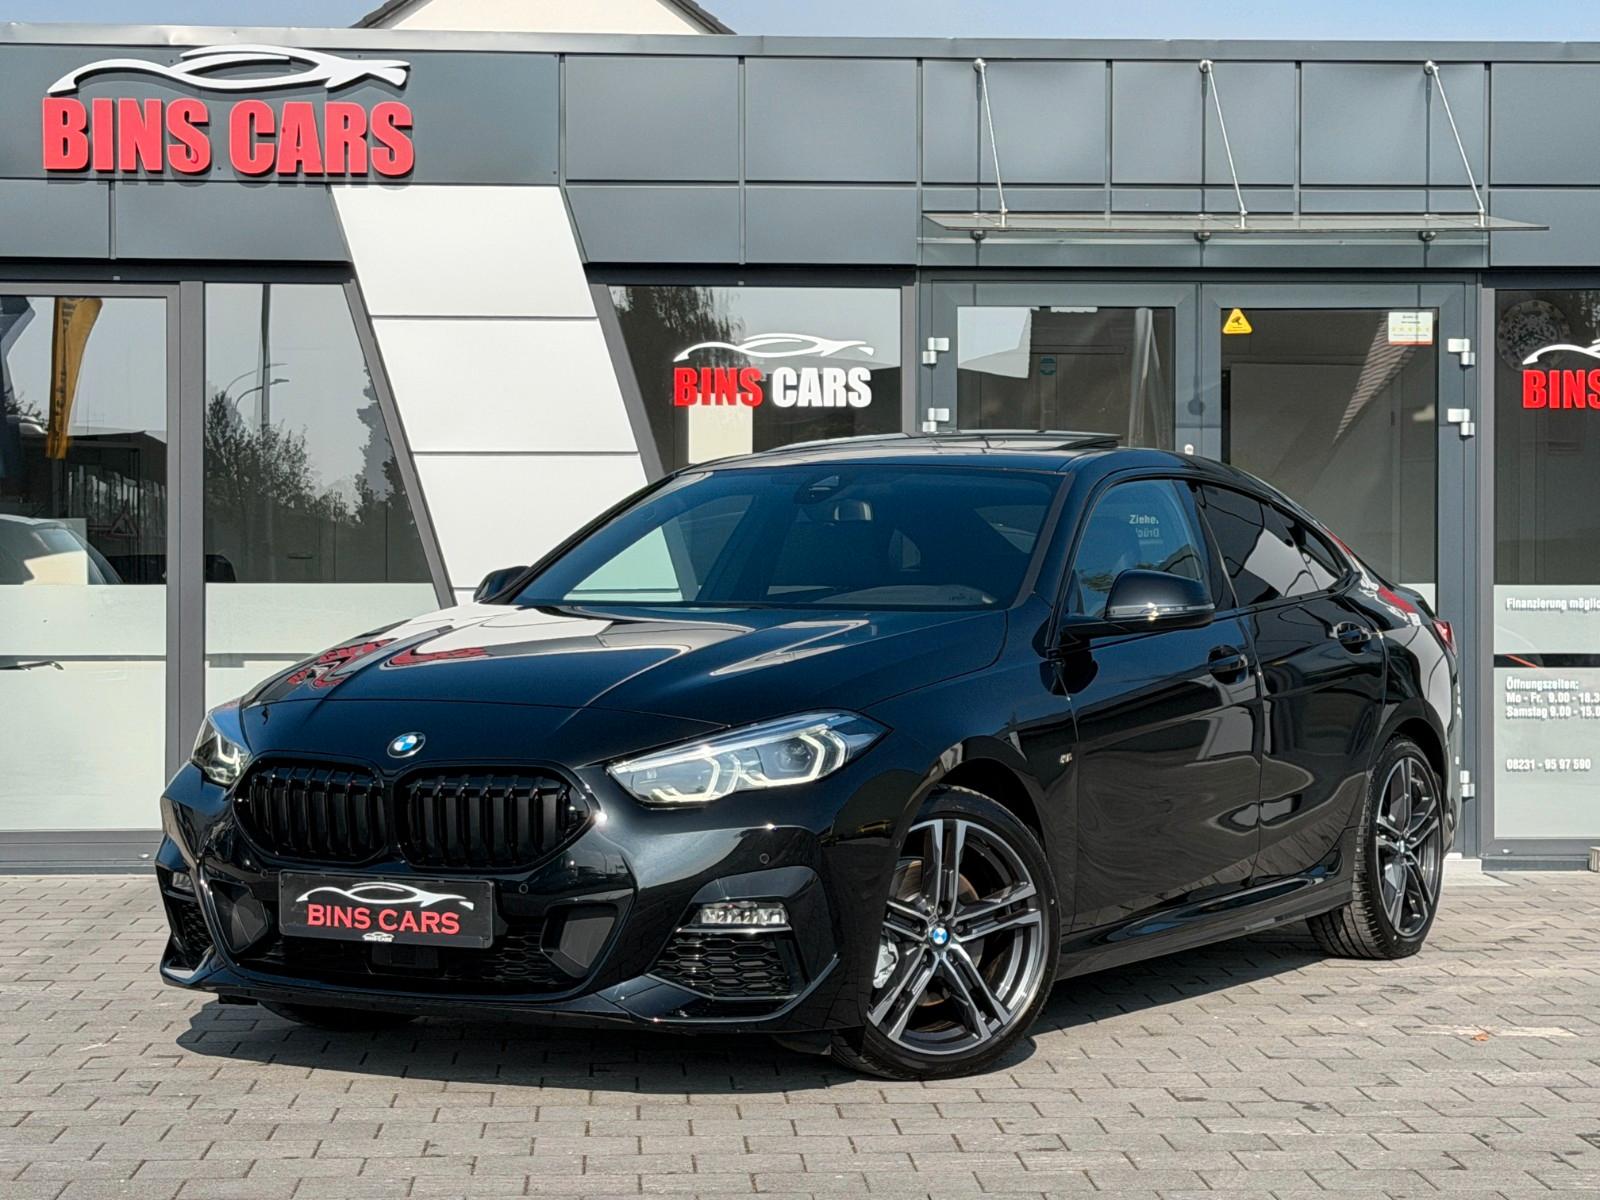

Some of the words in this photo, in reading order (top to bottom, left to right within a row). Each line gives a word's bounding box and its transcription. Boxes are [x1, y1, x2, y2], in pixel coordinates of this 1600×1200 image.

[43, 97, 212, 174] BINS
[229, 99, 416, 177] CARS
[673, 366, 764, 408] BINS
[772, 366, 873, 408] CARS
[1506, 598, 1567, 610] Finanzierung
[1506, 676, 1579, 691] Öffnungszeiten:
[1506, 692, 1521, 703] Mo
[1506, 706, 1548, 719] Samstag
[1549, 706, 1571, 717] 9.00
[307, 903, 371, 930] BINS
[379, 908, 460, 935] CARS
